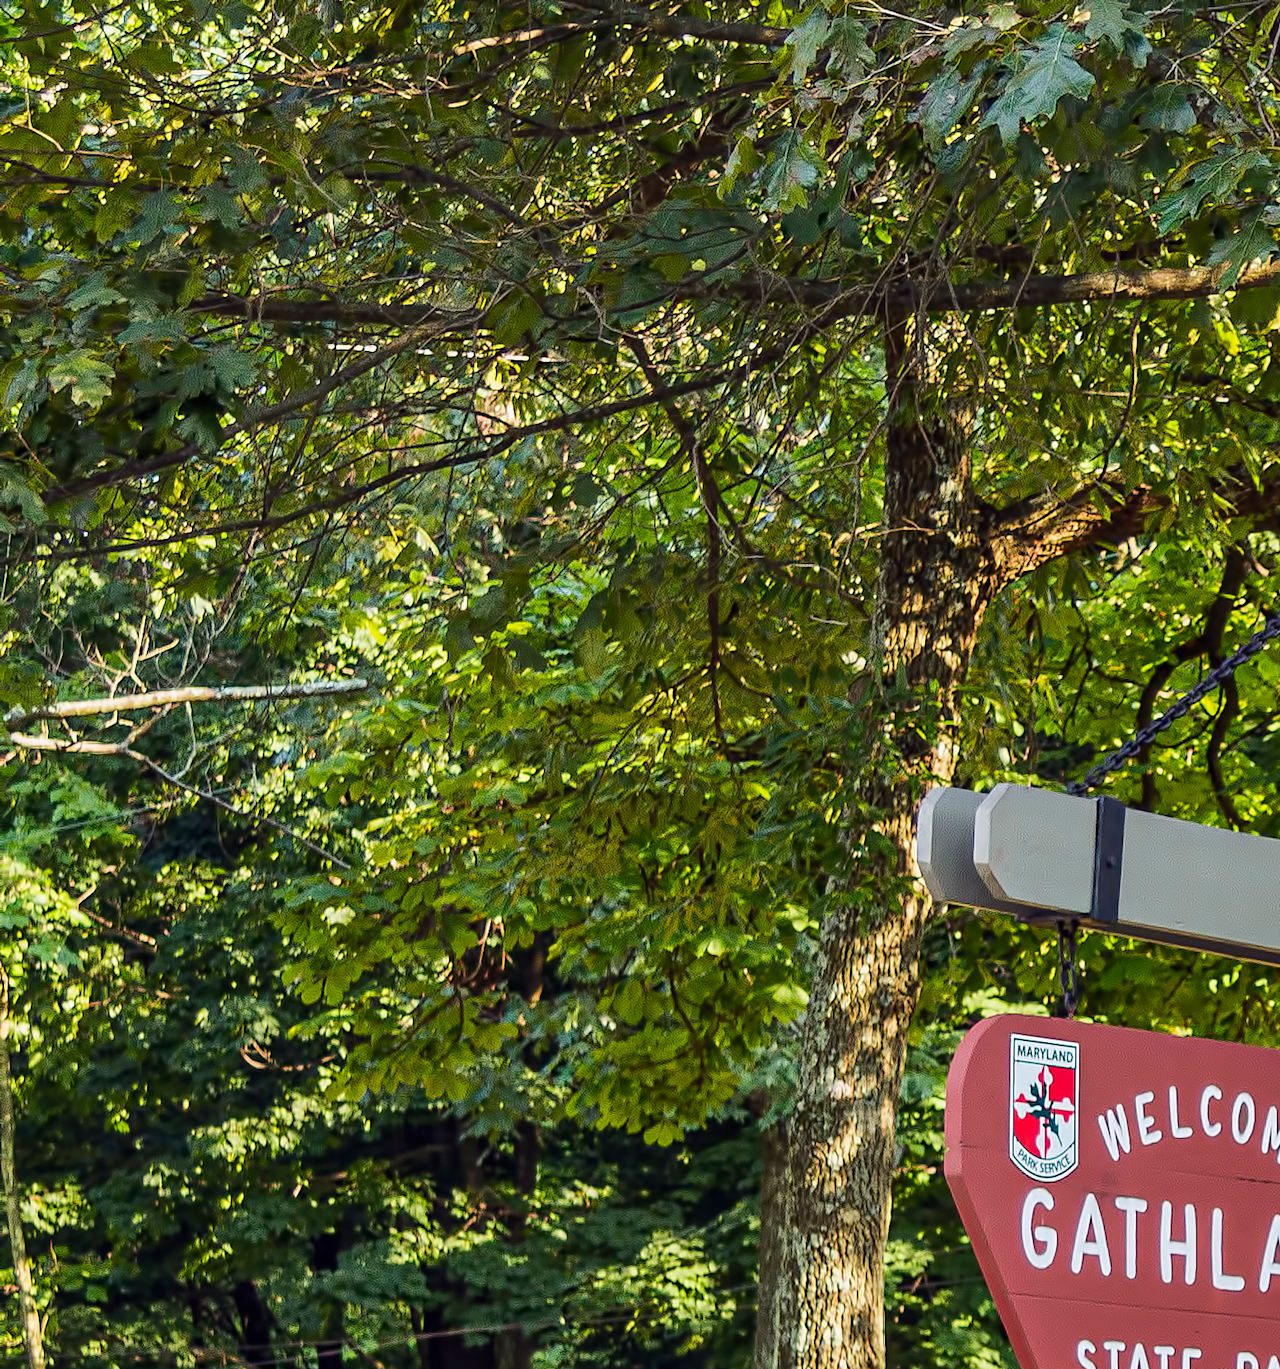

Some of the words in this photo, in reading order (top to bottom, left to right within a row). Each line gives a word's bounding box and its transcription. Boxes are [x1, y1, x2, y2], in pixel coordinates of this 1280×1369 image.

[1017, 1044, 1073, 1063] MARYLAND
[1018, 1149, 1039, 1173] PARK
[1039, 1153, 1072, 1174] SERVICE
